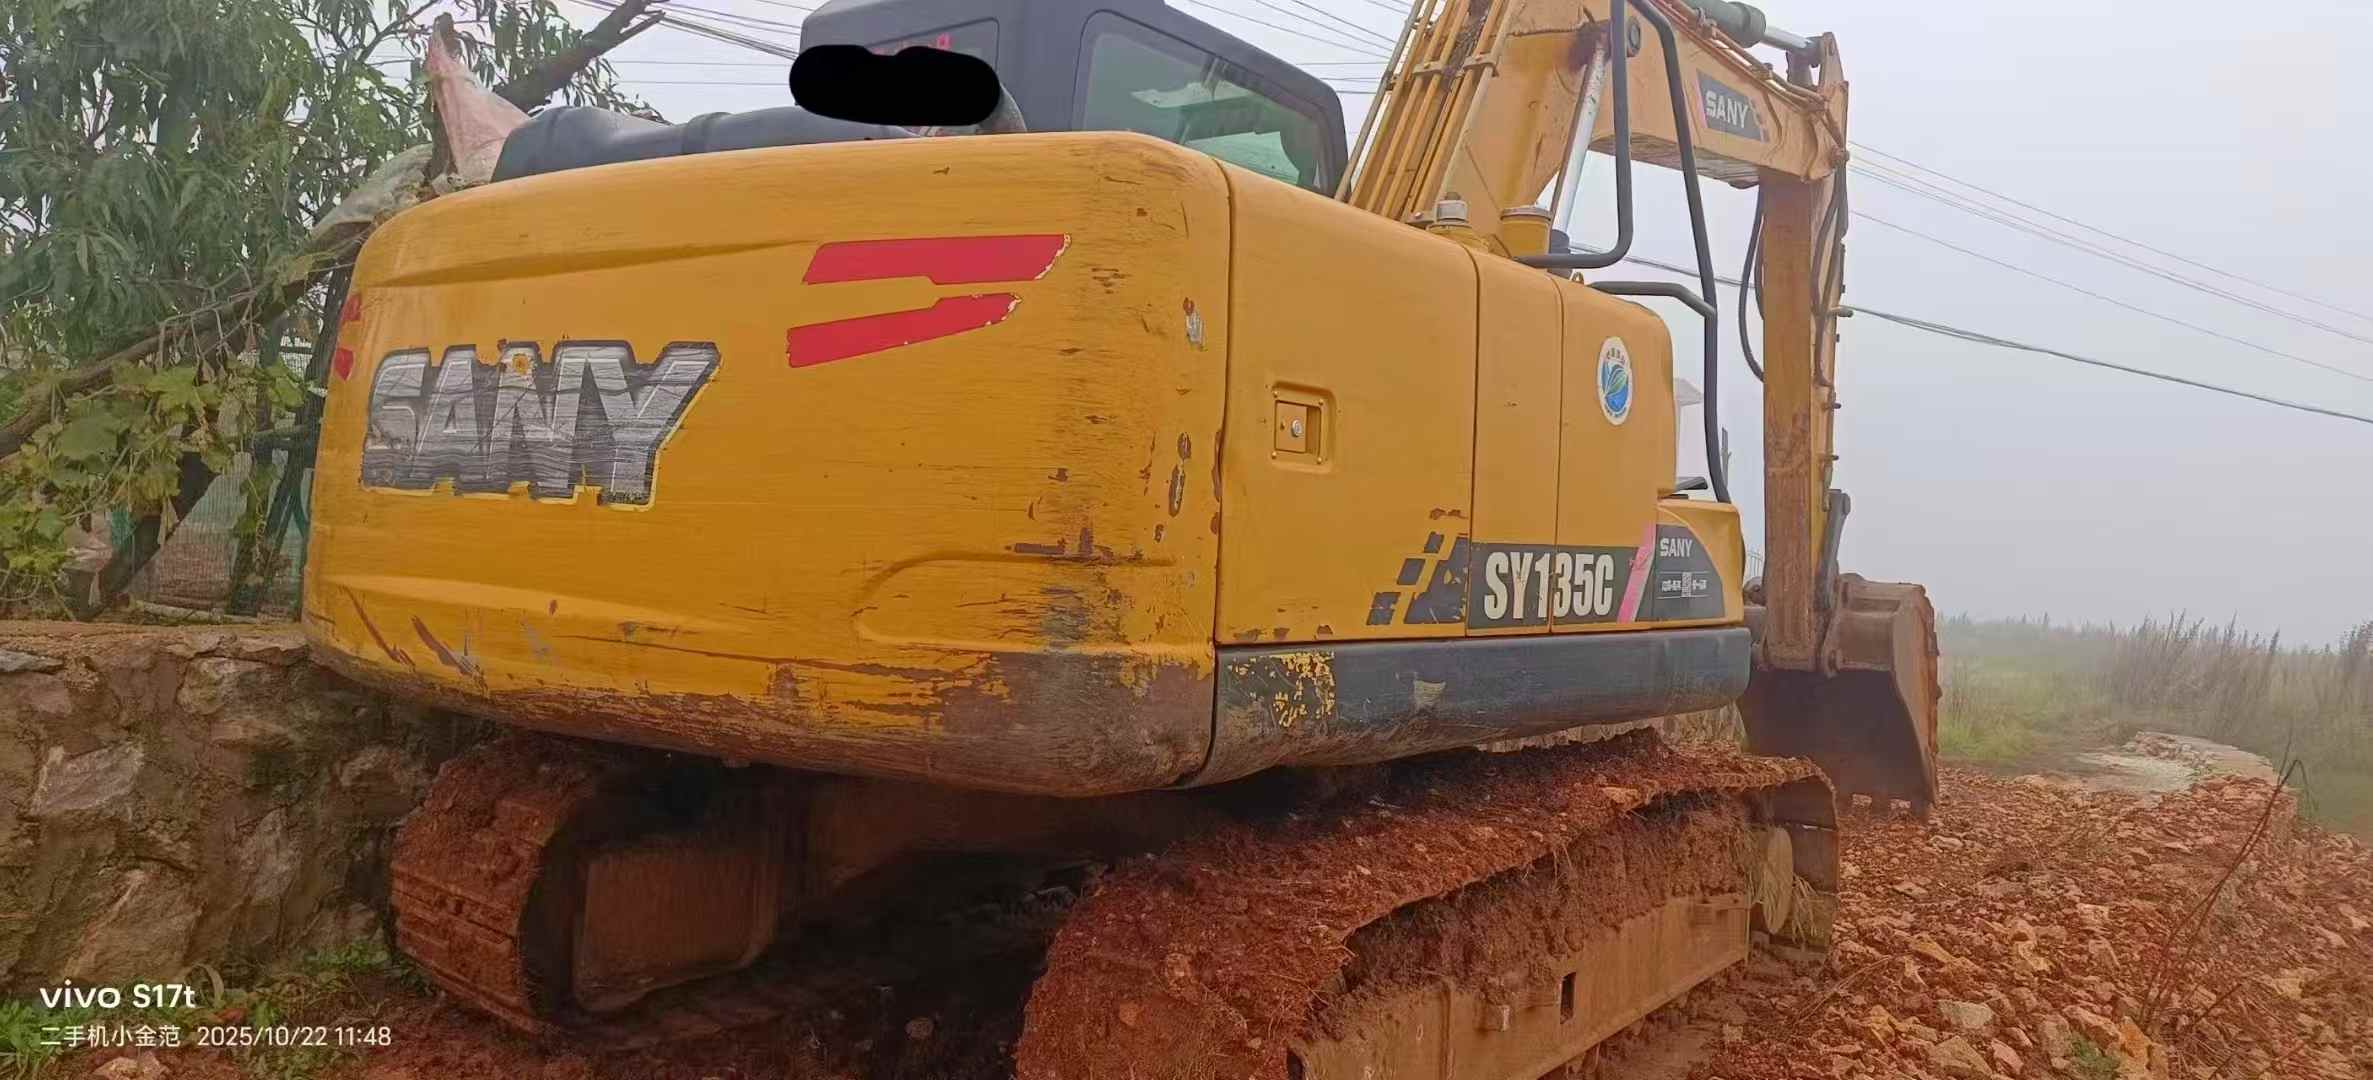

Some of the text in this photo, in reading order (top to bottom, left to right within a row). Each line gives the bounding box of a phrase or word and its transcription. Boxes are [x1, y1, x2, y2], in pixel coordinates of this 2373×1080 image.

[1705, 90, 1749, 129] SANY
[361, 340, 720, 511] SANY
[1659, 537, 1693, 558] SANY
[1484, 551, 1615, 620] SY135C
